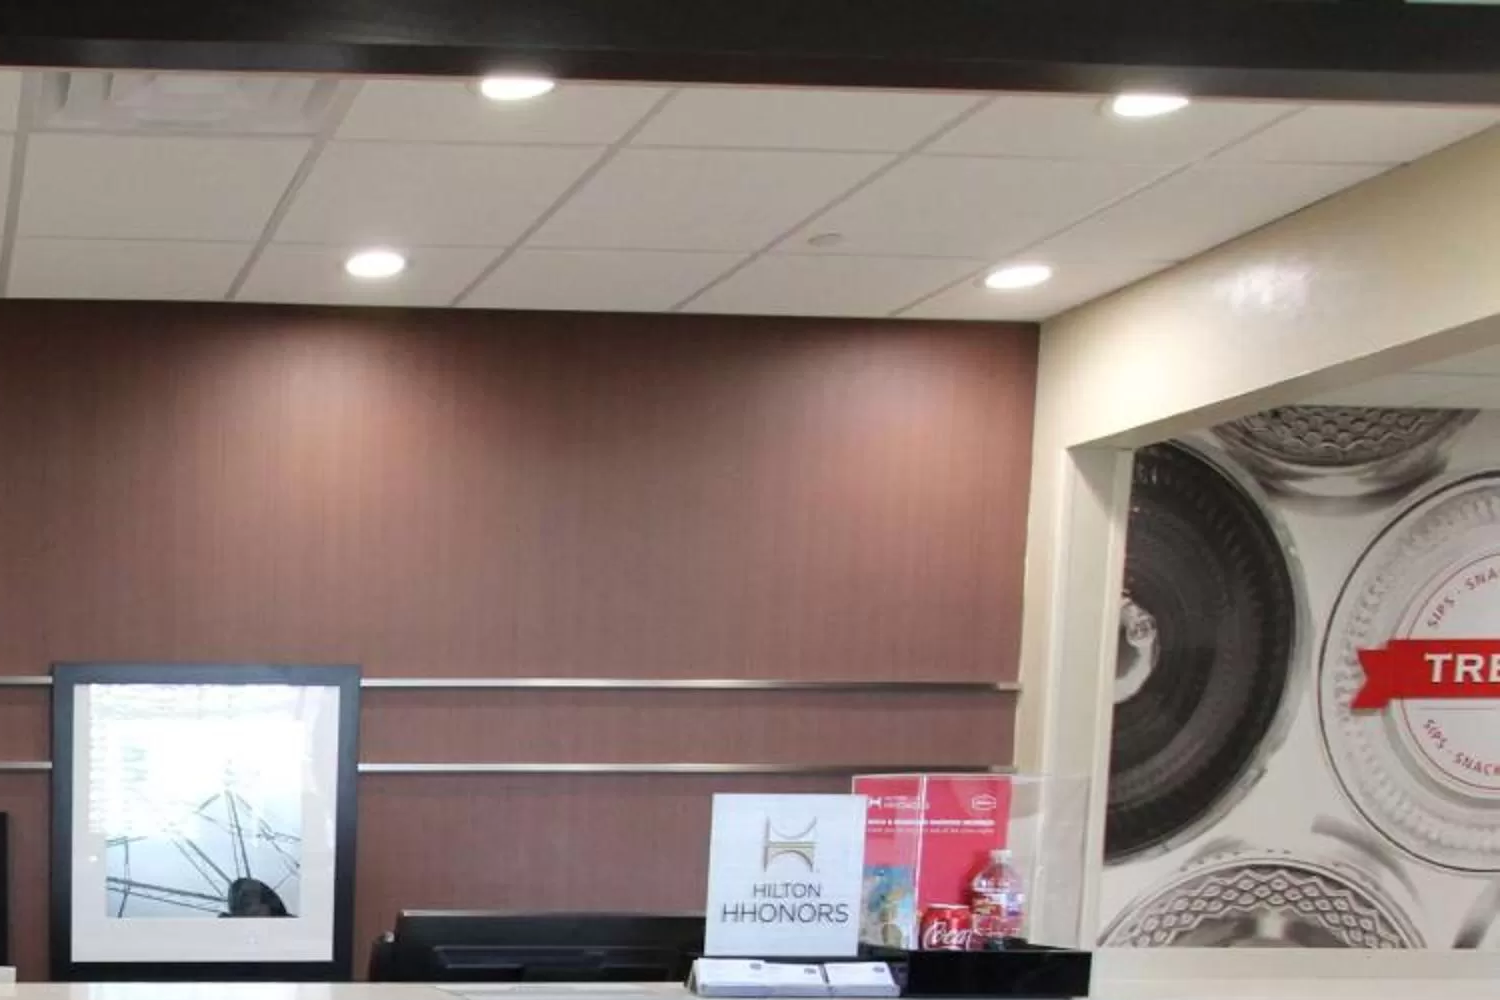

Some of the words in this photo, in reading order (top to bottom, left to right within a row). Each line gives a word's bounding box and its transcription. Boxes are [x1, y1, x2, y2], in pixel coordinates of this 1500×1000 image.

[1427, 595, 1455, 629] SIPS
[752, 882, 822, 899] HILTON
[721, 902, 849, 924] HHONORS
